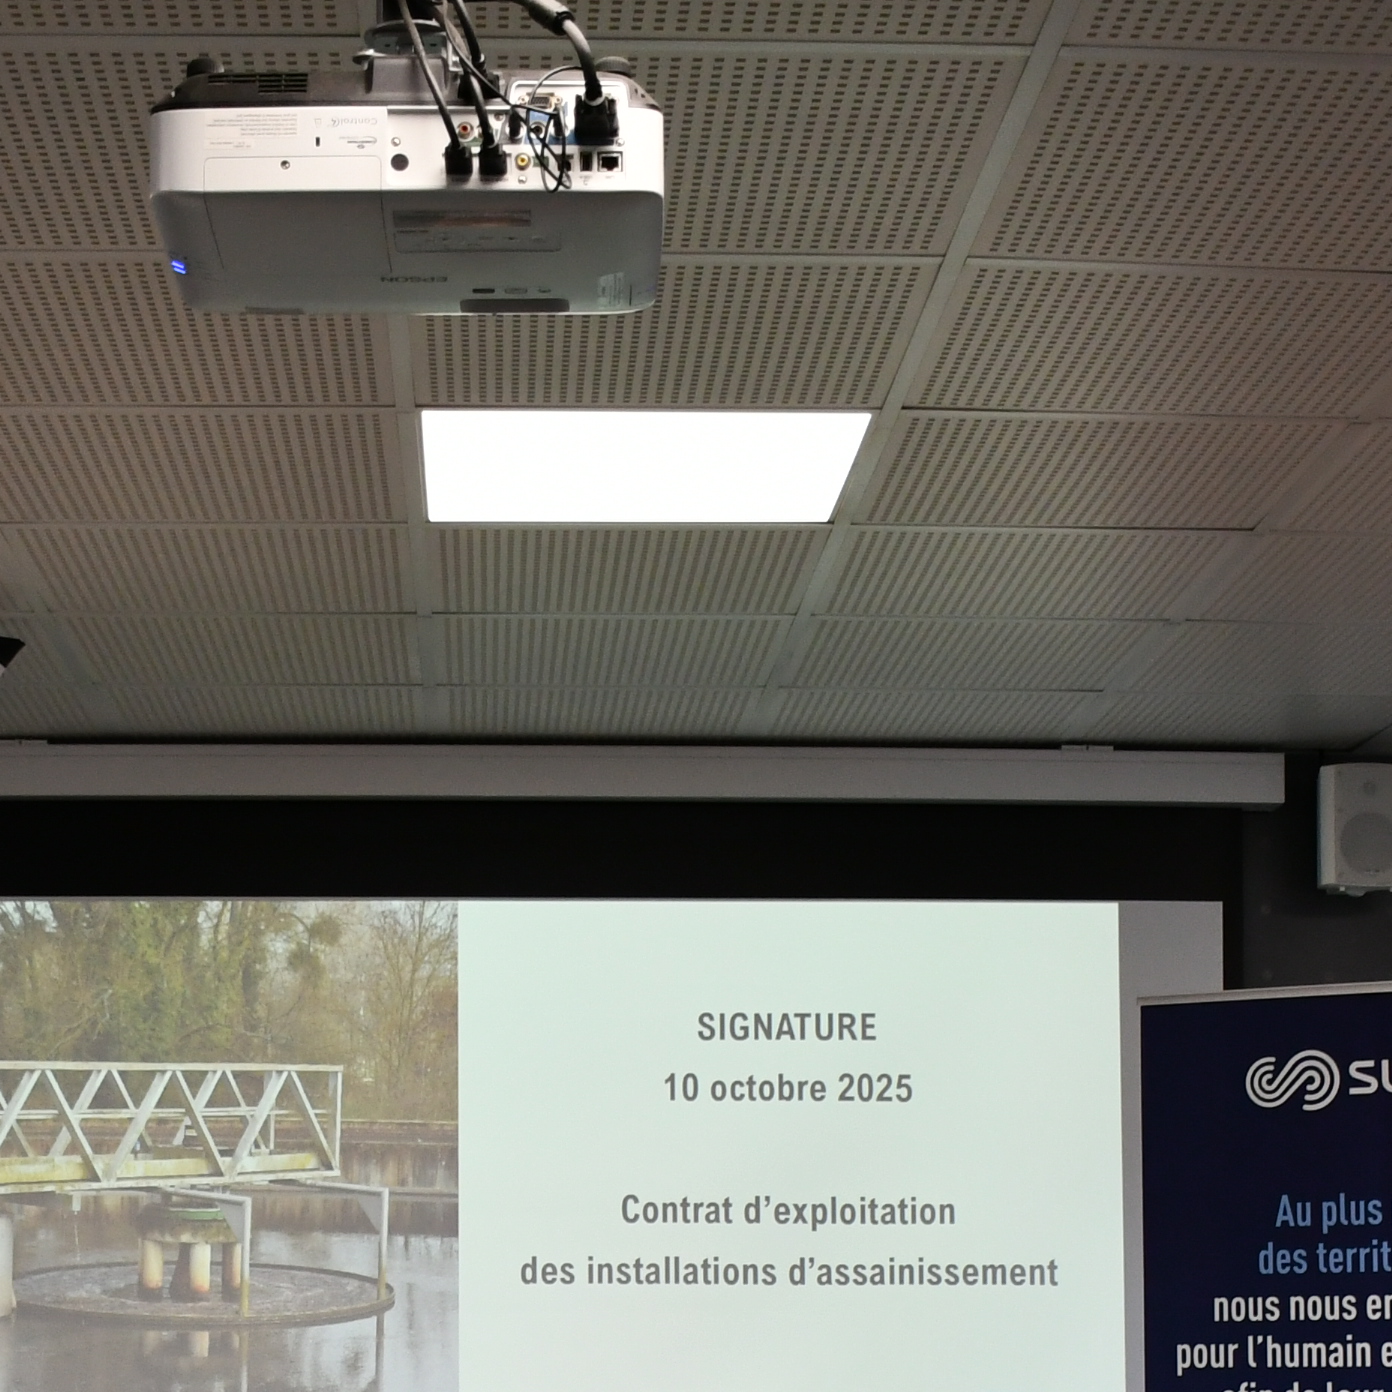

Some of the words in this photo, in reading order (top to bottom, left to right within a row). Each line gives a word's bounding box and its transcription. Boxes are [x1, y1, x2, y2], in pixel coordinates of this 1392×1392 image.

[697, 1012, 877, 1041] SIGNATURE
[664, 1072, 699, 1102] 10
[710, 1073, 827, 1102] octobre
[838, 1072, 913, 1103] 2025
[621, 1194, 733, 1224] Contrat
[744, 1195, 955, 1232] d’exploitation
[1275, 1194, 1312, 1228] Au
[1322, 1192, 1383, 1235] plus
[520, 1255, 575, 1285] des
[587, 1255, 777, 1286] installations
[788, 1256, 1059, 1287] d’assainissement
[1258, 1241, 1308, 1275] des
[1213, 1296, 1280, 1322] nous
[1289, 1294, 1357, 1321] nous
[1176, 1343, 1239, 1377] pour
[1247, 1334, 1372, 1368] l’humain
